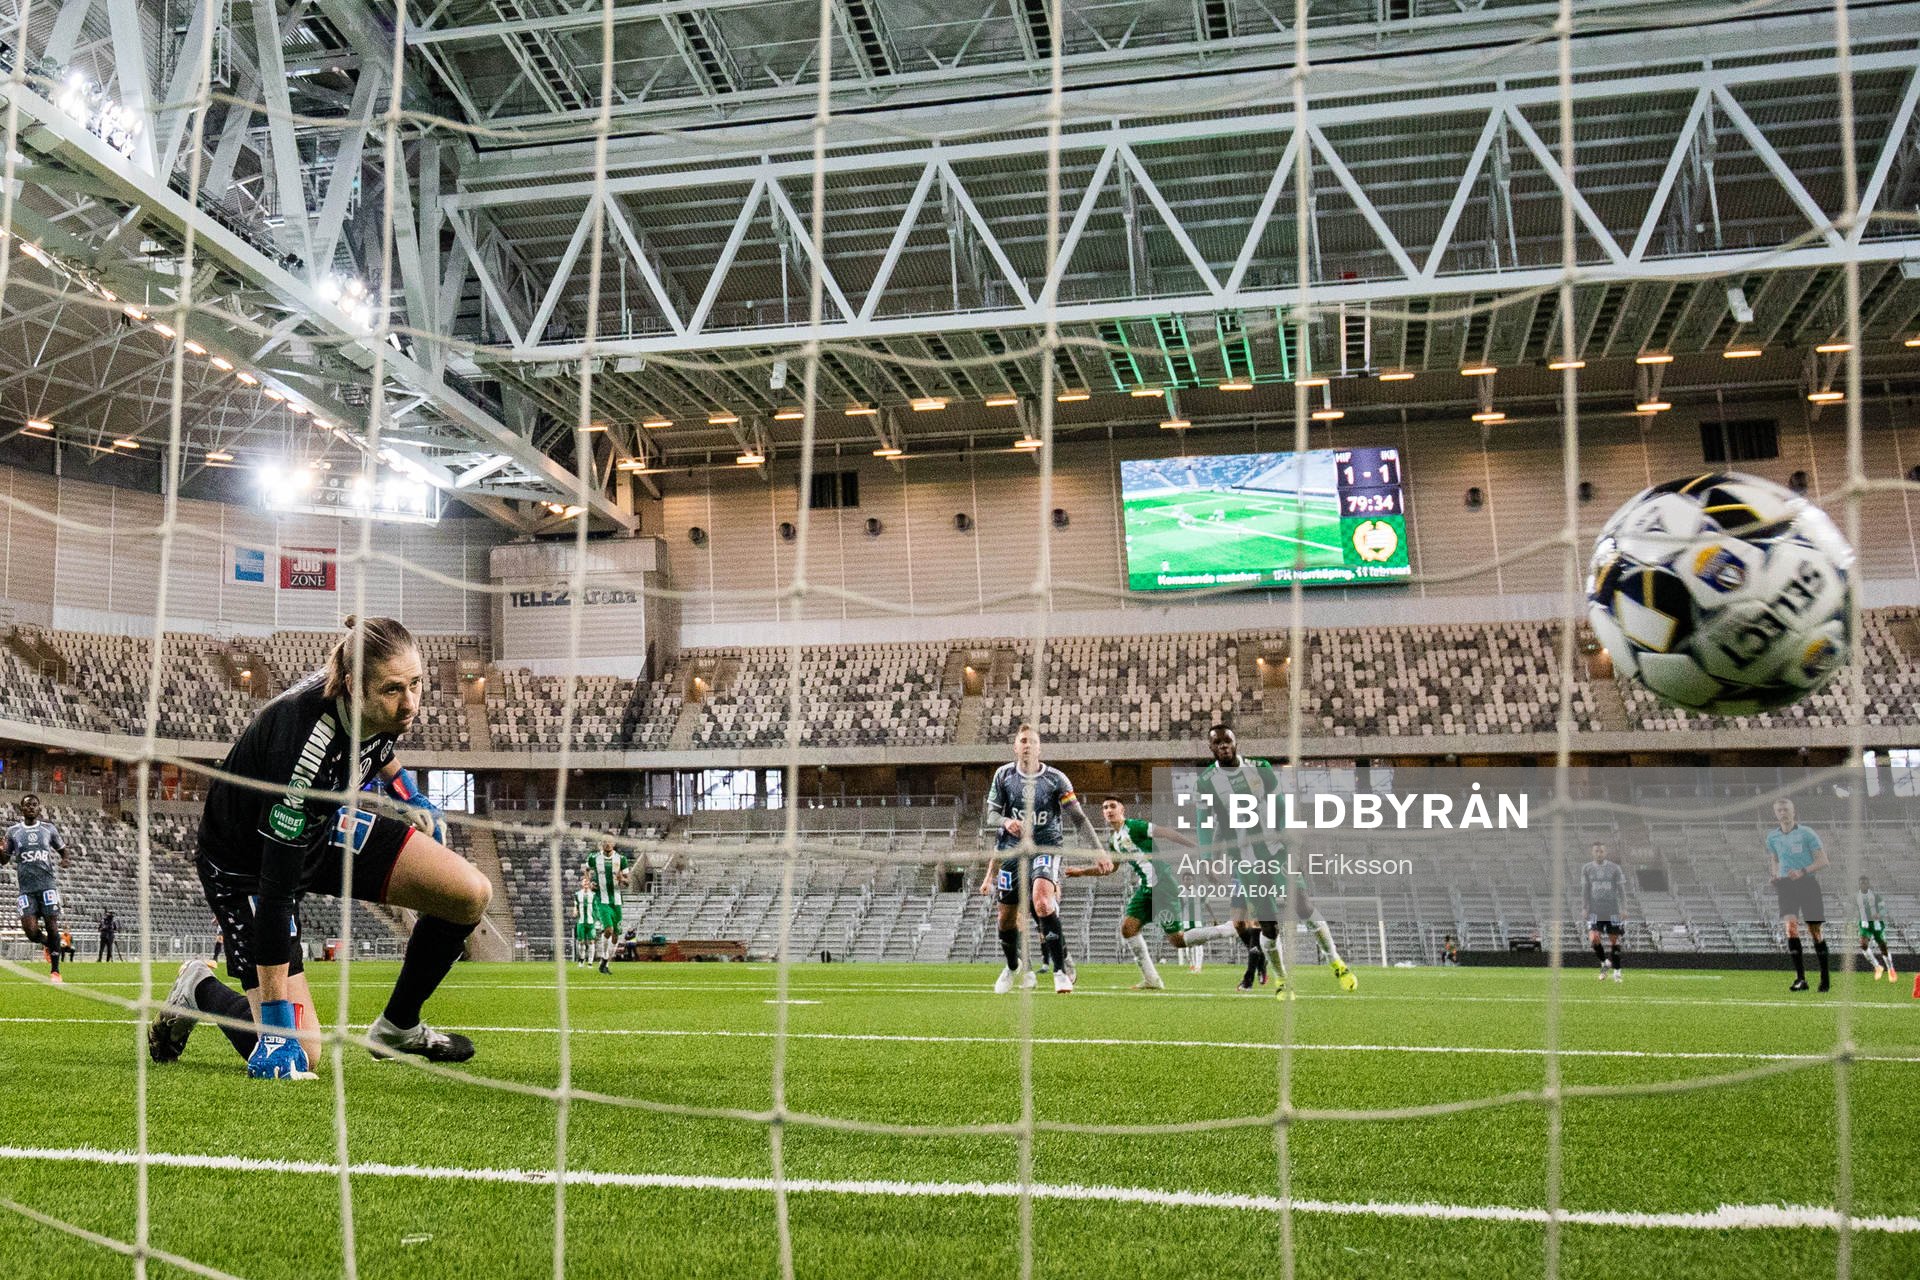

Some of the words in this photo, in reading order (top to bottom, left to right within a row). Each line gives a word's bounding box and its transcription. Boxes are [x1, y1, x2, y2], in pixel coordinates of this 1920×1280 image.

[1344, 466, 1354, 485] 1
[1379, 464, 1389, 483] 1
[1346, 494, 1394, 512] 79:34
[290, 575, 326, 587] ZONE
[510, 583, 571, 607] TELE2
[274, 809, 304, 827] UNIBET
[20, 850, 50, 863] SSAB
